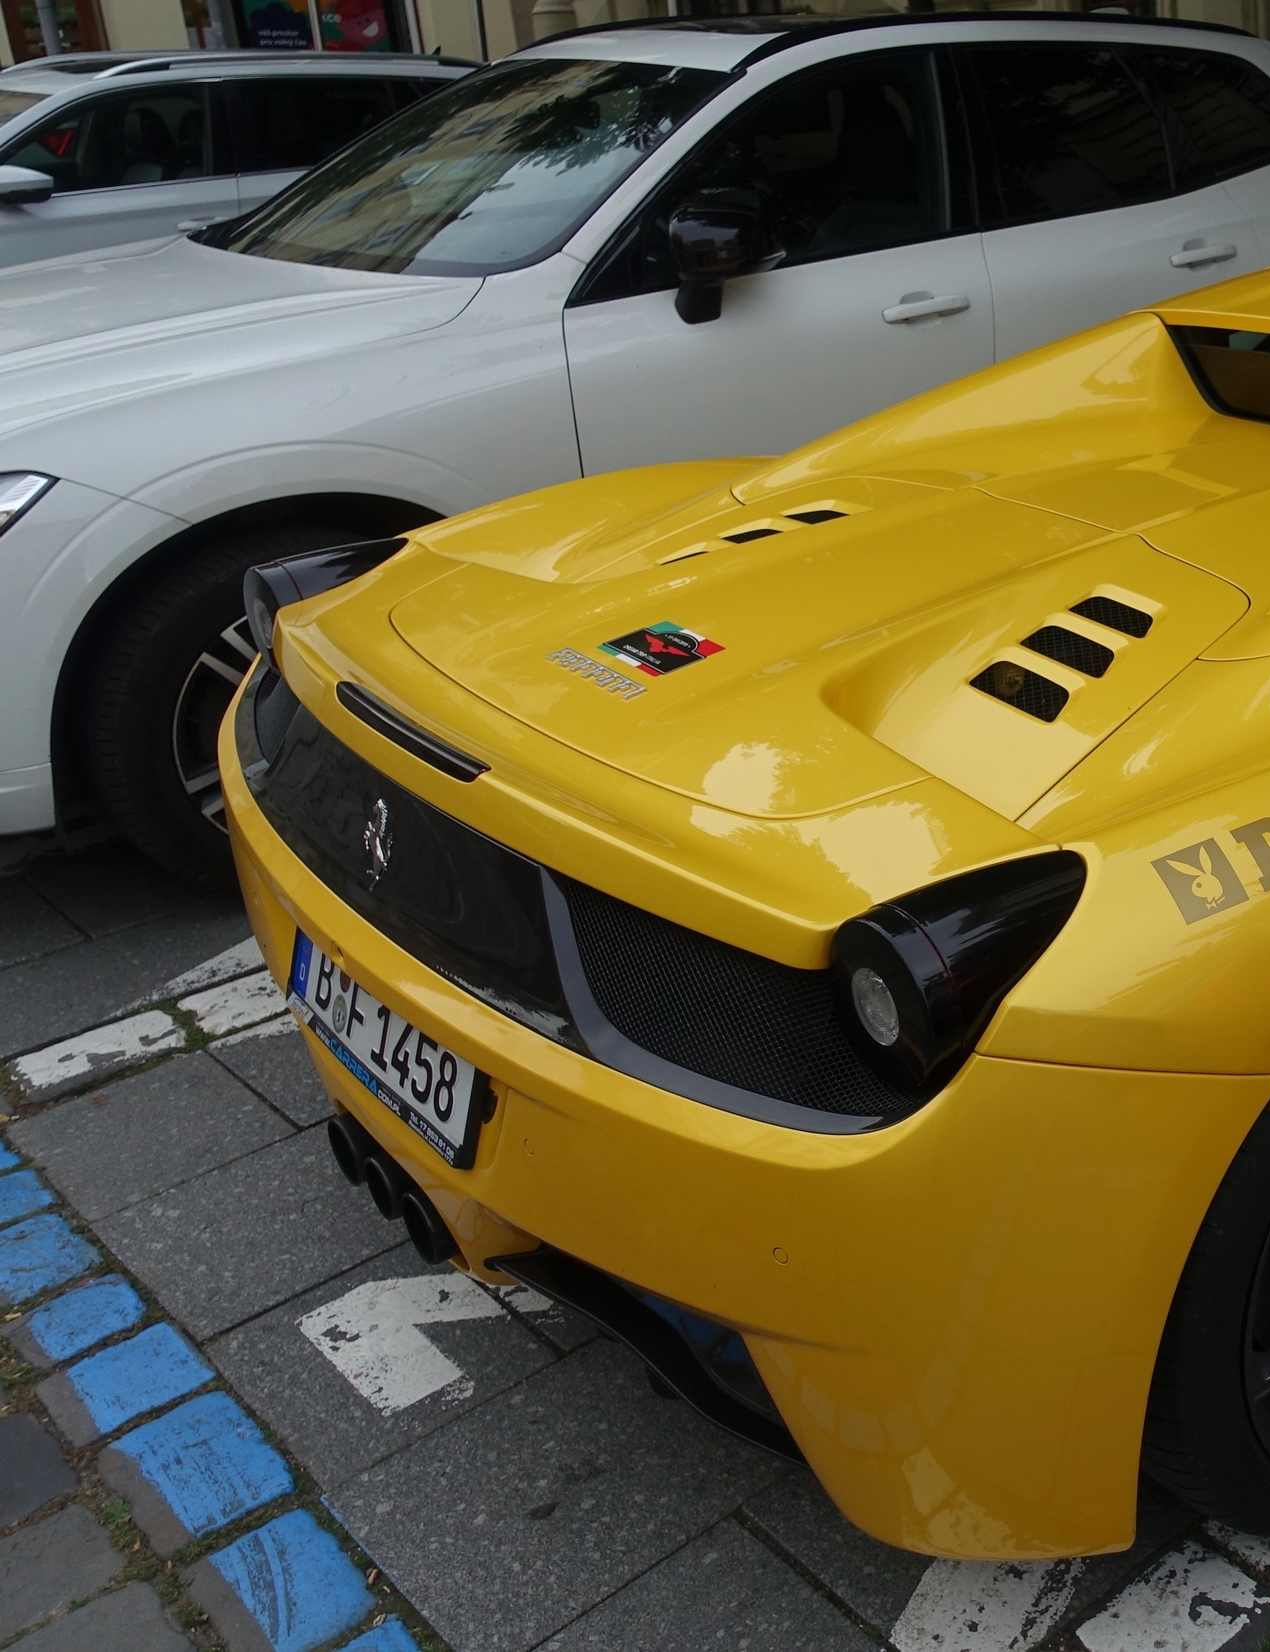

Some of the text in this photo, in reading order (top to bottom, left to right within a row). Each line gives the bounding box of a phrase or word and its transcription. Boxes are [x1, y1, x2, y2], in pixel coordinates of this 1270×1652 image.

[546, 647, 647, 701] Ferrari
[299, 962, 306, 982] D
[315, 951, 459, 1123] B F 1458
